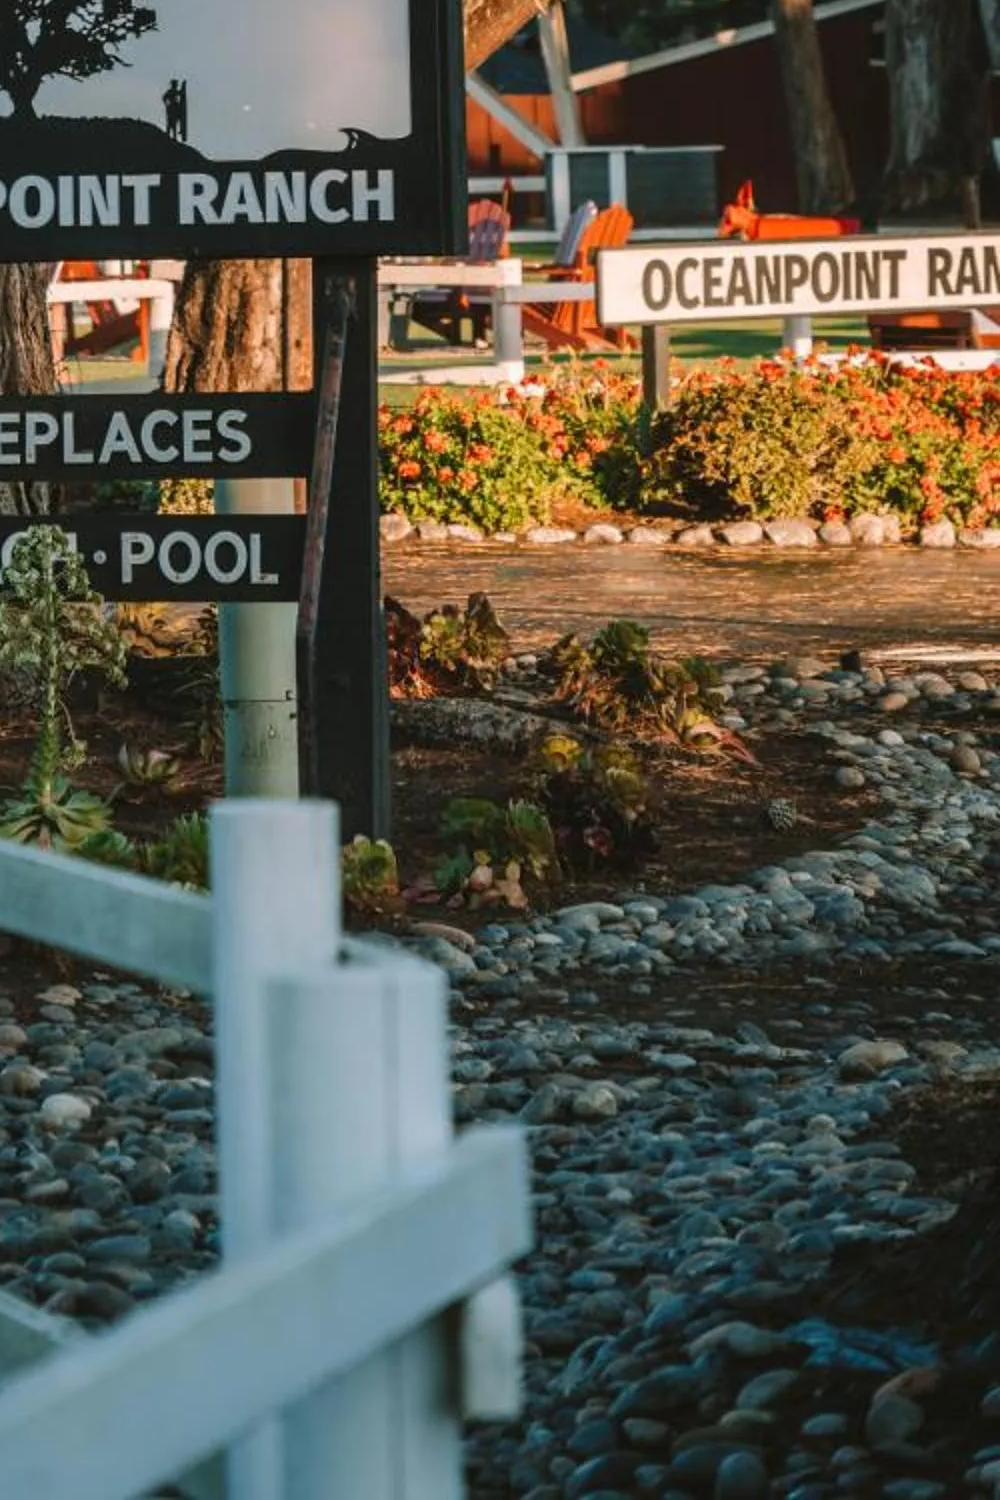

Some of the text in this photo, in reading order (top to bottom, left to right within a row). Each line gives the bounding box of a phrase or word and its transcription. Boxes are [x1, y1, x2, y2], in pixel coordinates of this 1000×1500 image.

[179, 169, 395, 225] RANCH
[642, 250, 907, 311] OCEANPOINT
[121, 531, 279, 584] POOL
